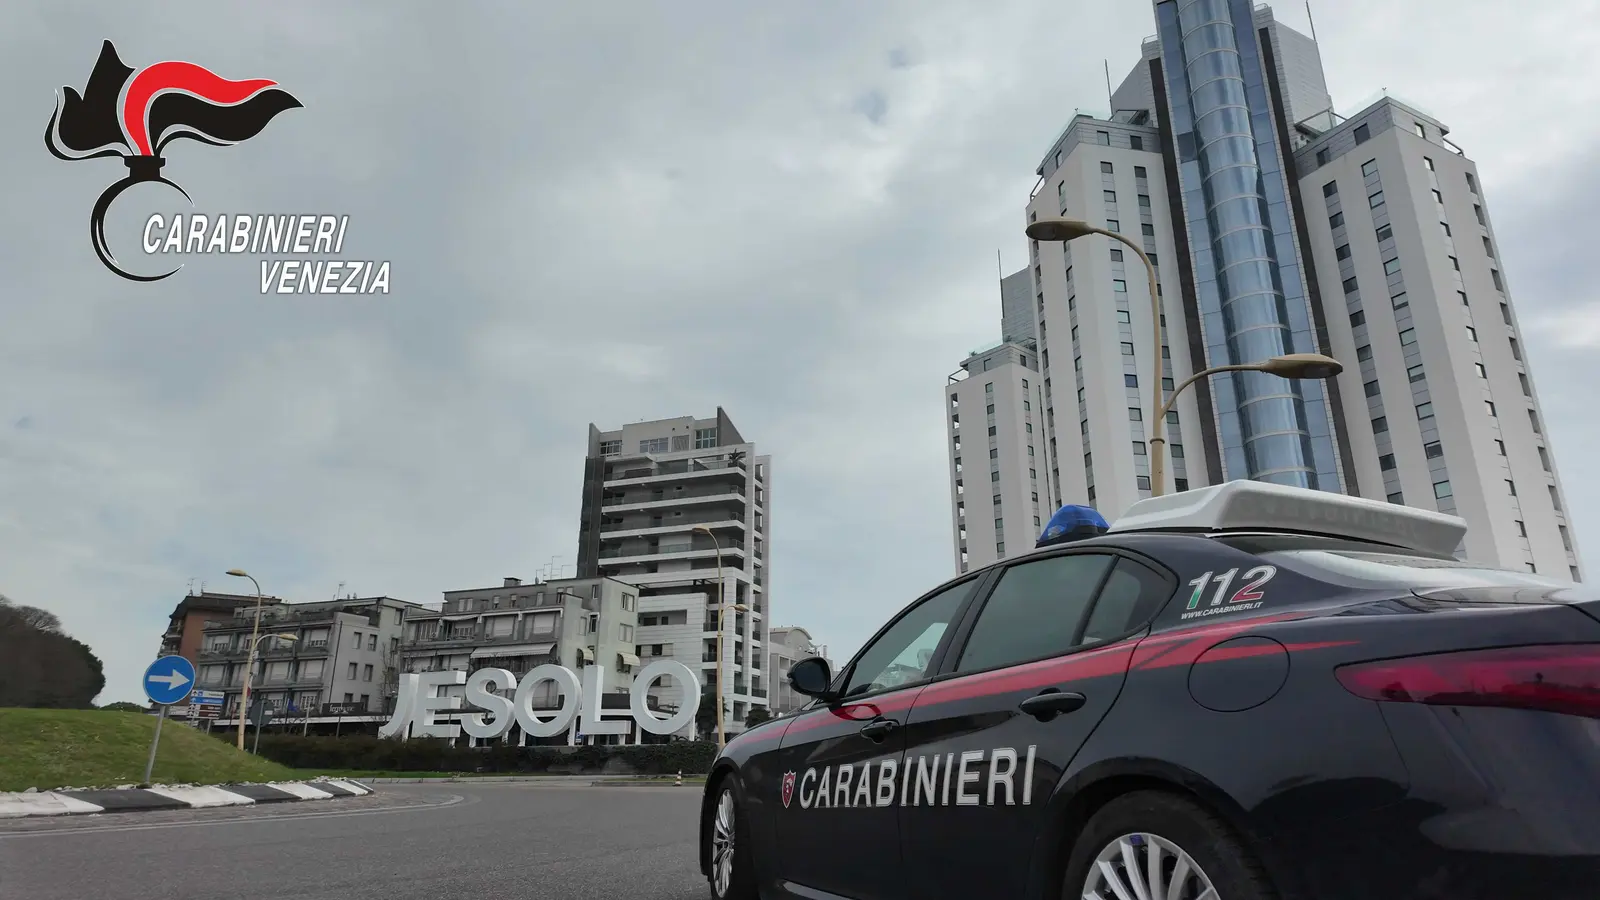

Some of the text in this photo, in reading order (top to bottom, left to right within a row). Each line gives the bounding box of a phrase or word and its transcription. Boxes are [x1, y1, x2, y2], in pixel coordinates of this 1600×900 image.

[1181, 601, 1264, 620] WWW.CARABINIERI.IT
[1186, 564, 1277, 610] 112
[378, 659, 702, 740] JESOLO
[799, 744, 1037, 809] CARABINIERI
